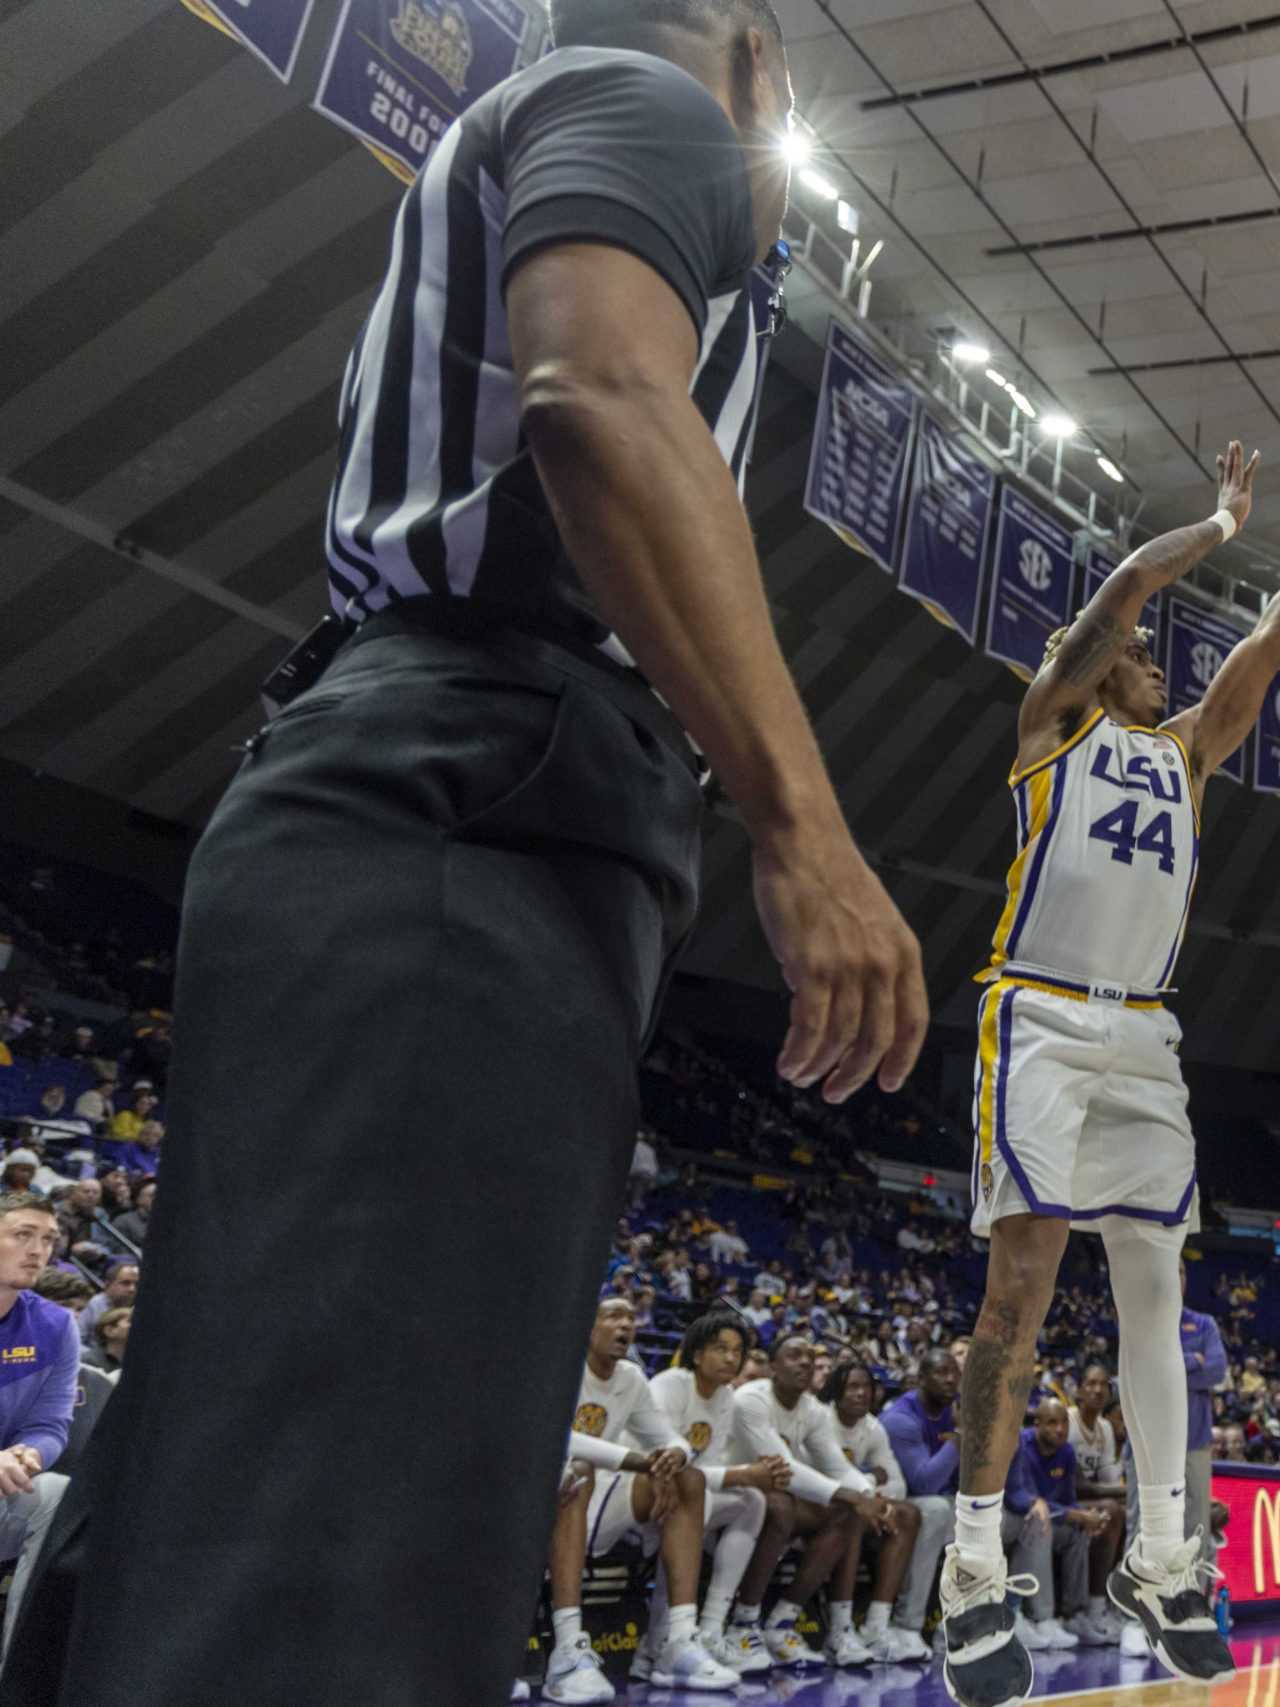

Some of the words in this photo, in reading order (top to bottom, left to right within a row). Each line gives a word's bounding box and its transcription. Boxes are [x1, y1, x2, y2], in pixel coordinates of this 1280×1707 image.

[366, 61, 416, 111] FINAL
[418, 106, 449, 138] FO
[1090, 743, 1182, 804] LSU
[1088, 799, 1176, 876] 44
[1094, 986, 1123, 1001] LSU
[2, 1347, 36, 1359] LSU
